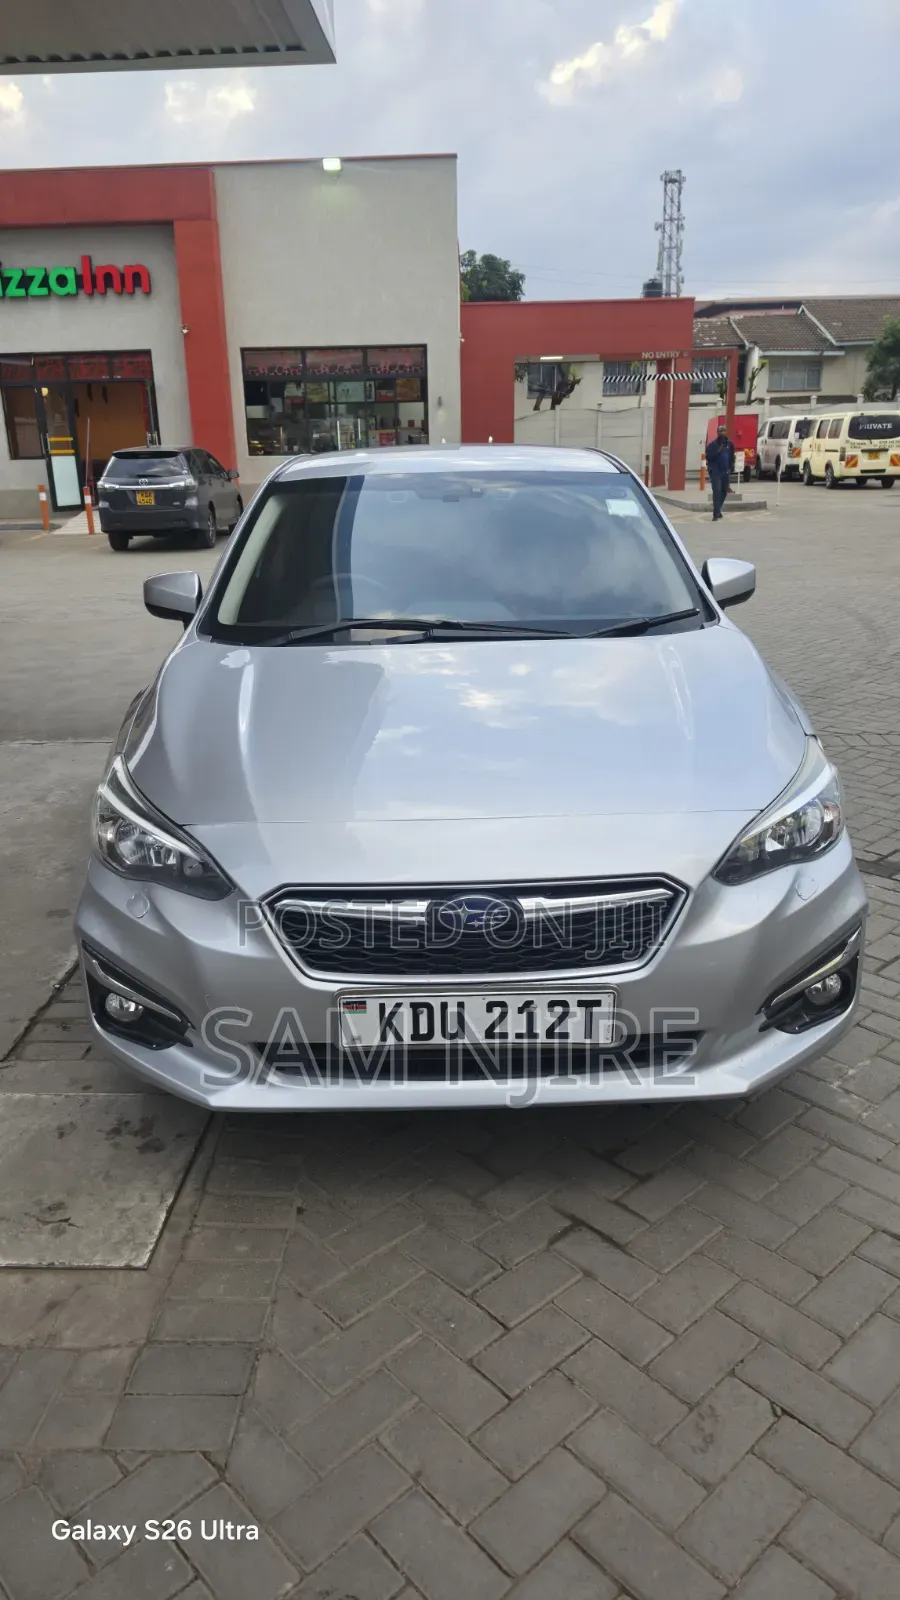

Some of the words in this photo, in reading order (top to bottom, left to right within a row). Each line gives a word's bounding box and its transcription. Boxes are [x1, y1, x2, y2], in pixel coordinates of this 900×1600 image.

[0, 266, 77, 297] zza
[378, 1000, 467, 1043] KDU
[484, 999, 602, 1041] 212T
